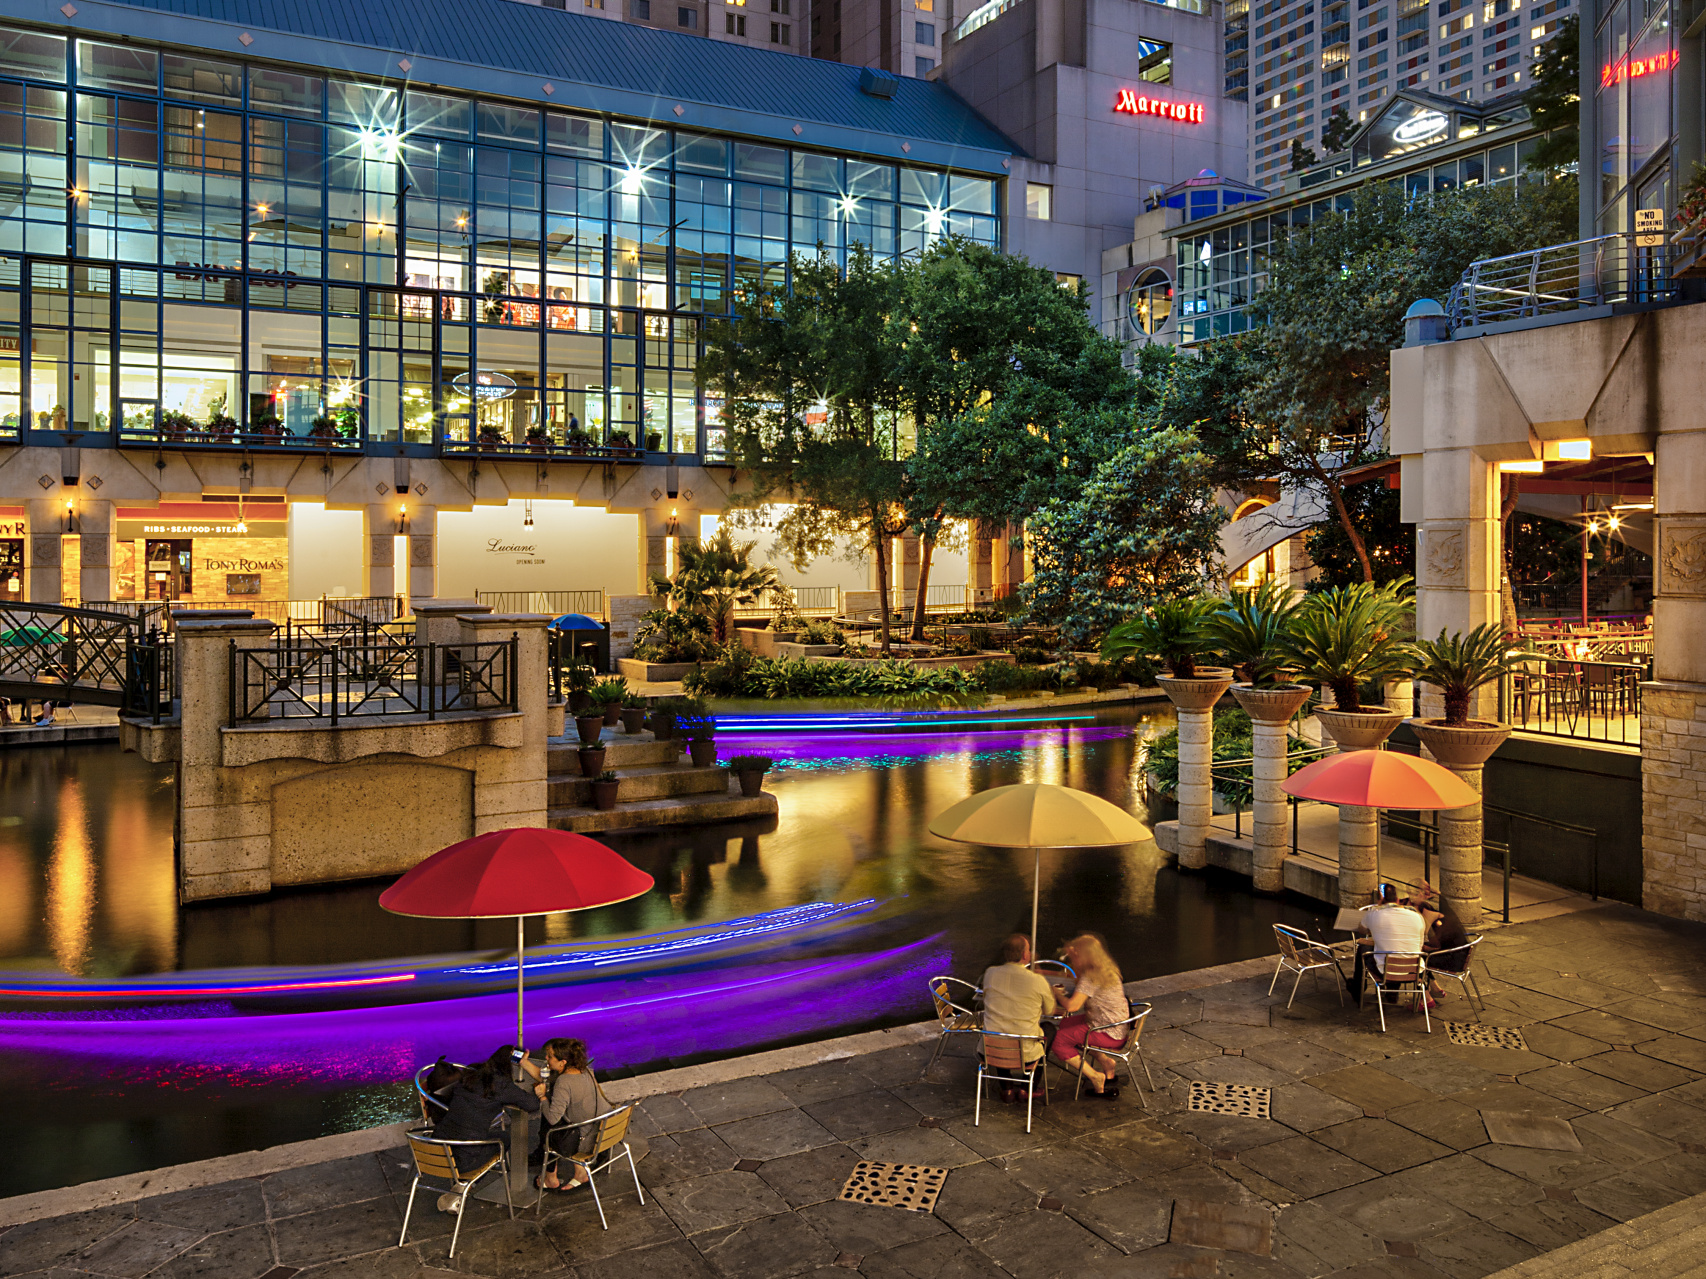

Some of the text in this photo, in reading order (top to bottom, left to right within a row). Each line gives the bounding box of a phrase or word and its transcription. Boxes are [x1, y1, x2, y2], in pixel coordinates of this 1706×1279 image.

[1115, 89, 1203, 123] Marriott
[1644, 211, 1654, 219] NO
[0, 338, 17, 349] ITY
[486, 538, 536, 552] Luciano
[203, 558, 238, 571] TONY
